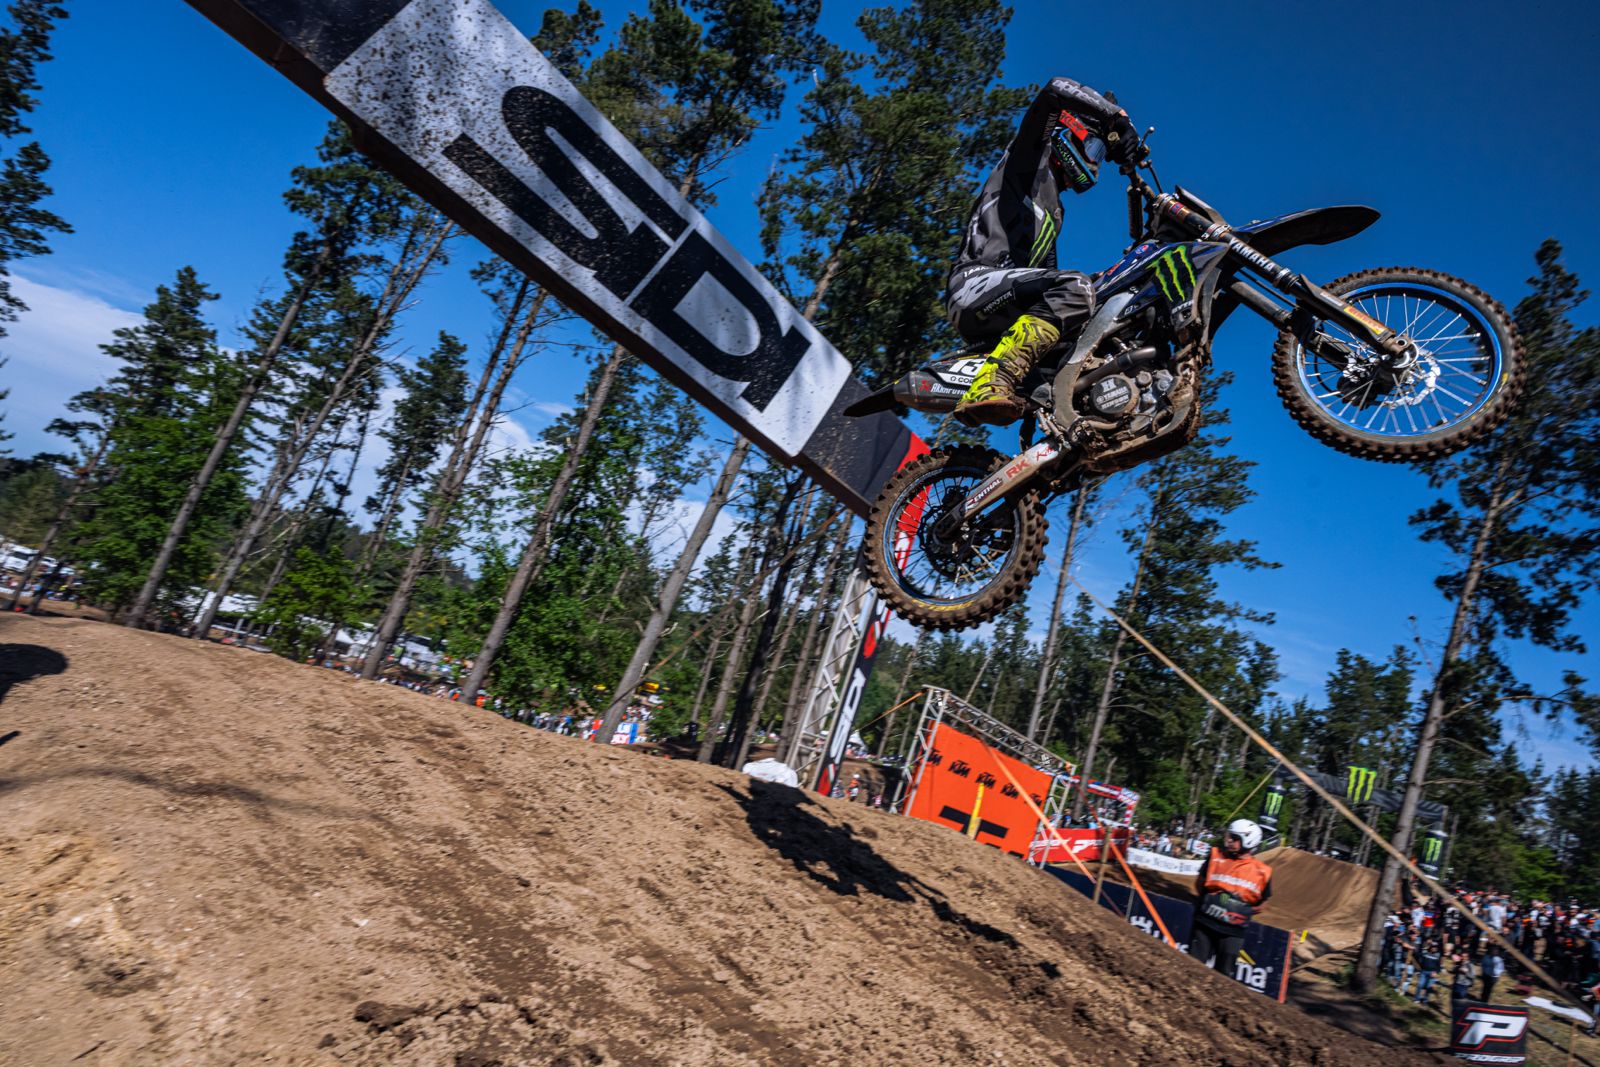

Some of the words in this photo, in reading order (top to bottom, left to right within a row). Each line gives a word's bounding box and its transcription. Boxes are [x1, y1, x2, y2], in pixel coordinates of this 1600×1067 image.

[1229, 236, 1276, 272] YAMAHA
[1005, 460, 1031, 479] RK
[964, 478, 1002, 513] RENTHAL
[948, 759, 972, 778] KTM
[975, 771, 996, 790] KTM
[1000, 782, 1020, 799] KTM
